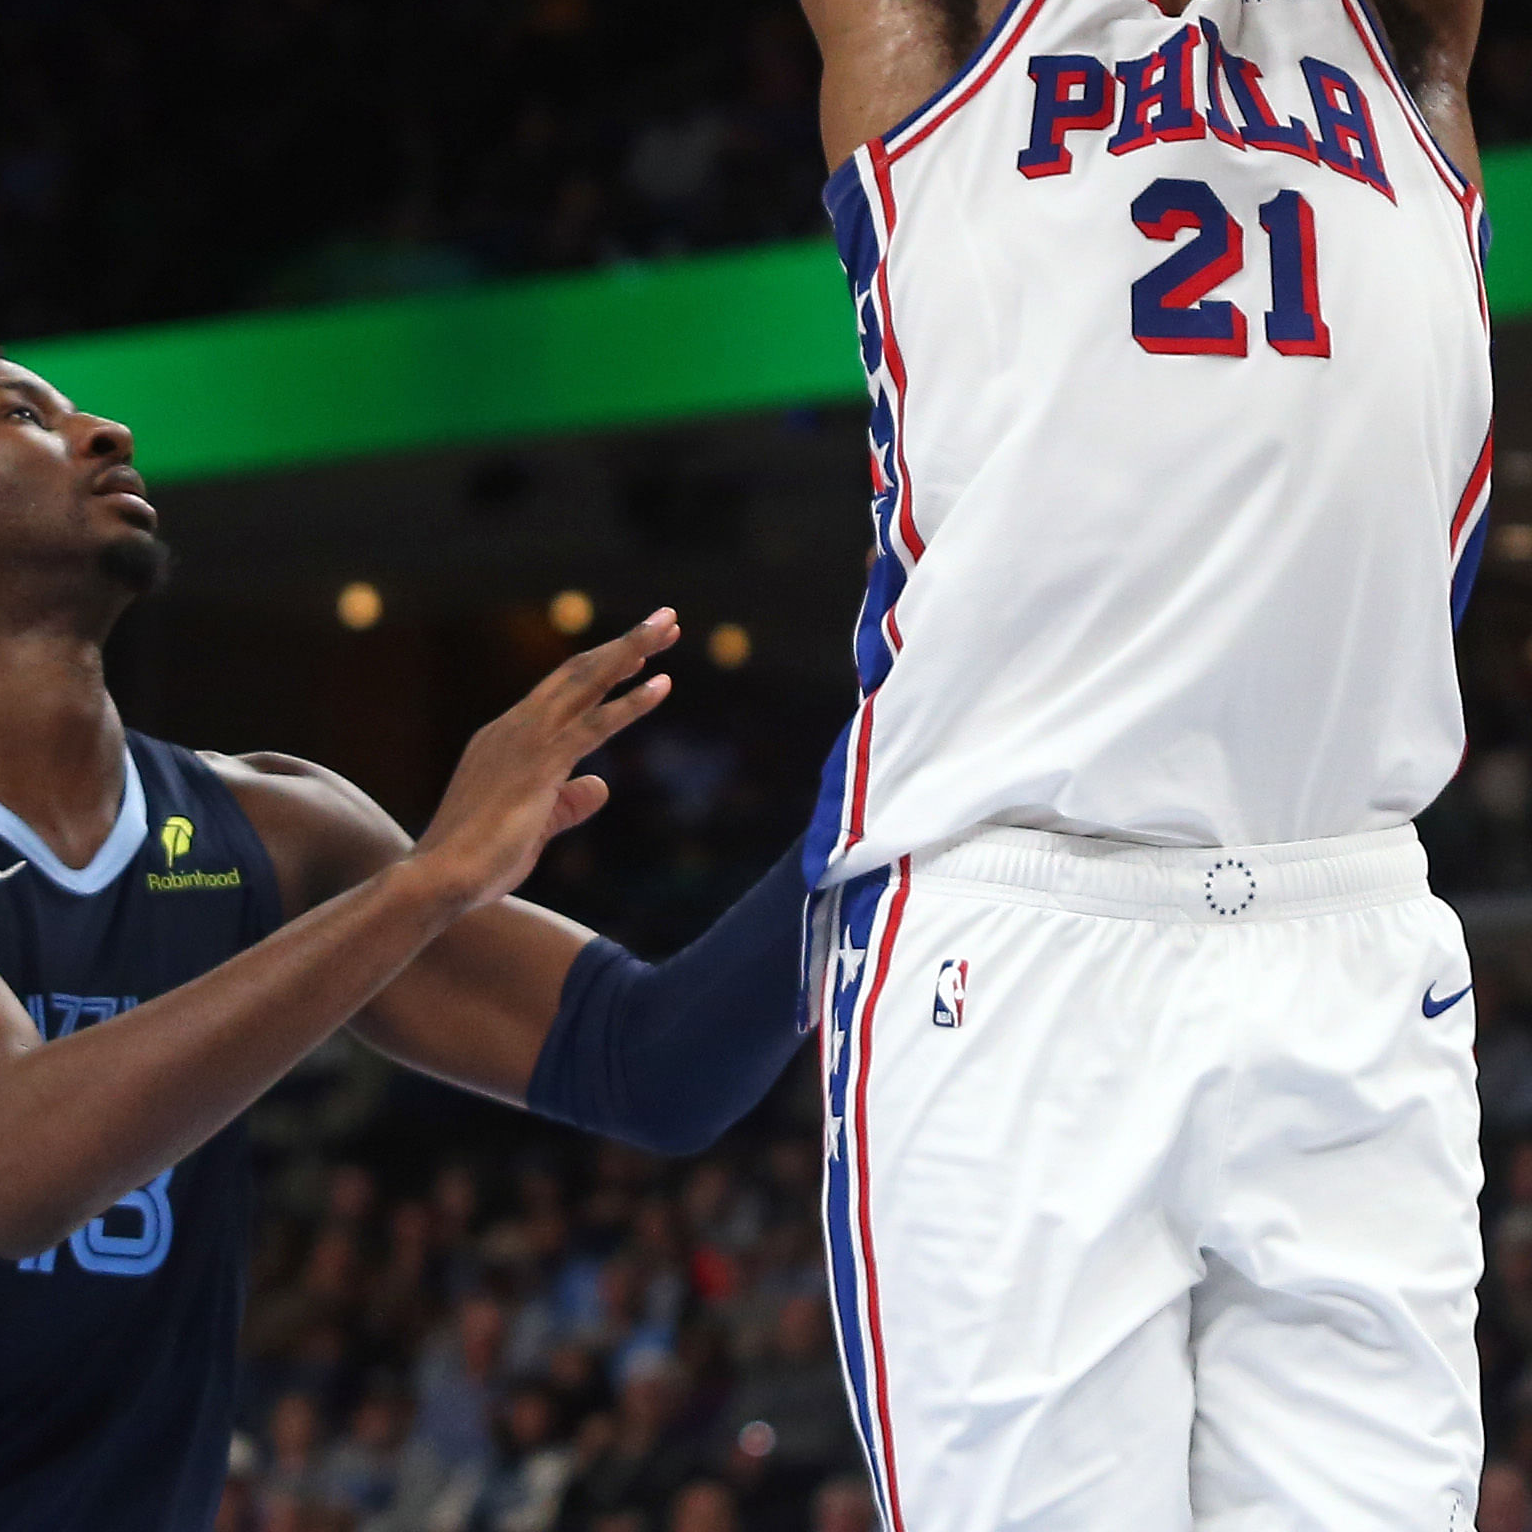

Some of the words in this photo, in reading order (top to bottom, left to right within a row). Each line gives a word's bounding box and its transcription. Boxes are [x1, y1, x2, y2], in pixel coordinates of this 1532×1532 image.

[1017, 16, 1398, 206] PHILA
[1130, 177, 1332, 358] 21
[147, 867, 241, 891] Robinhood
